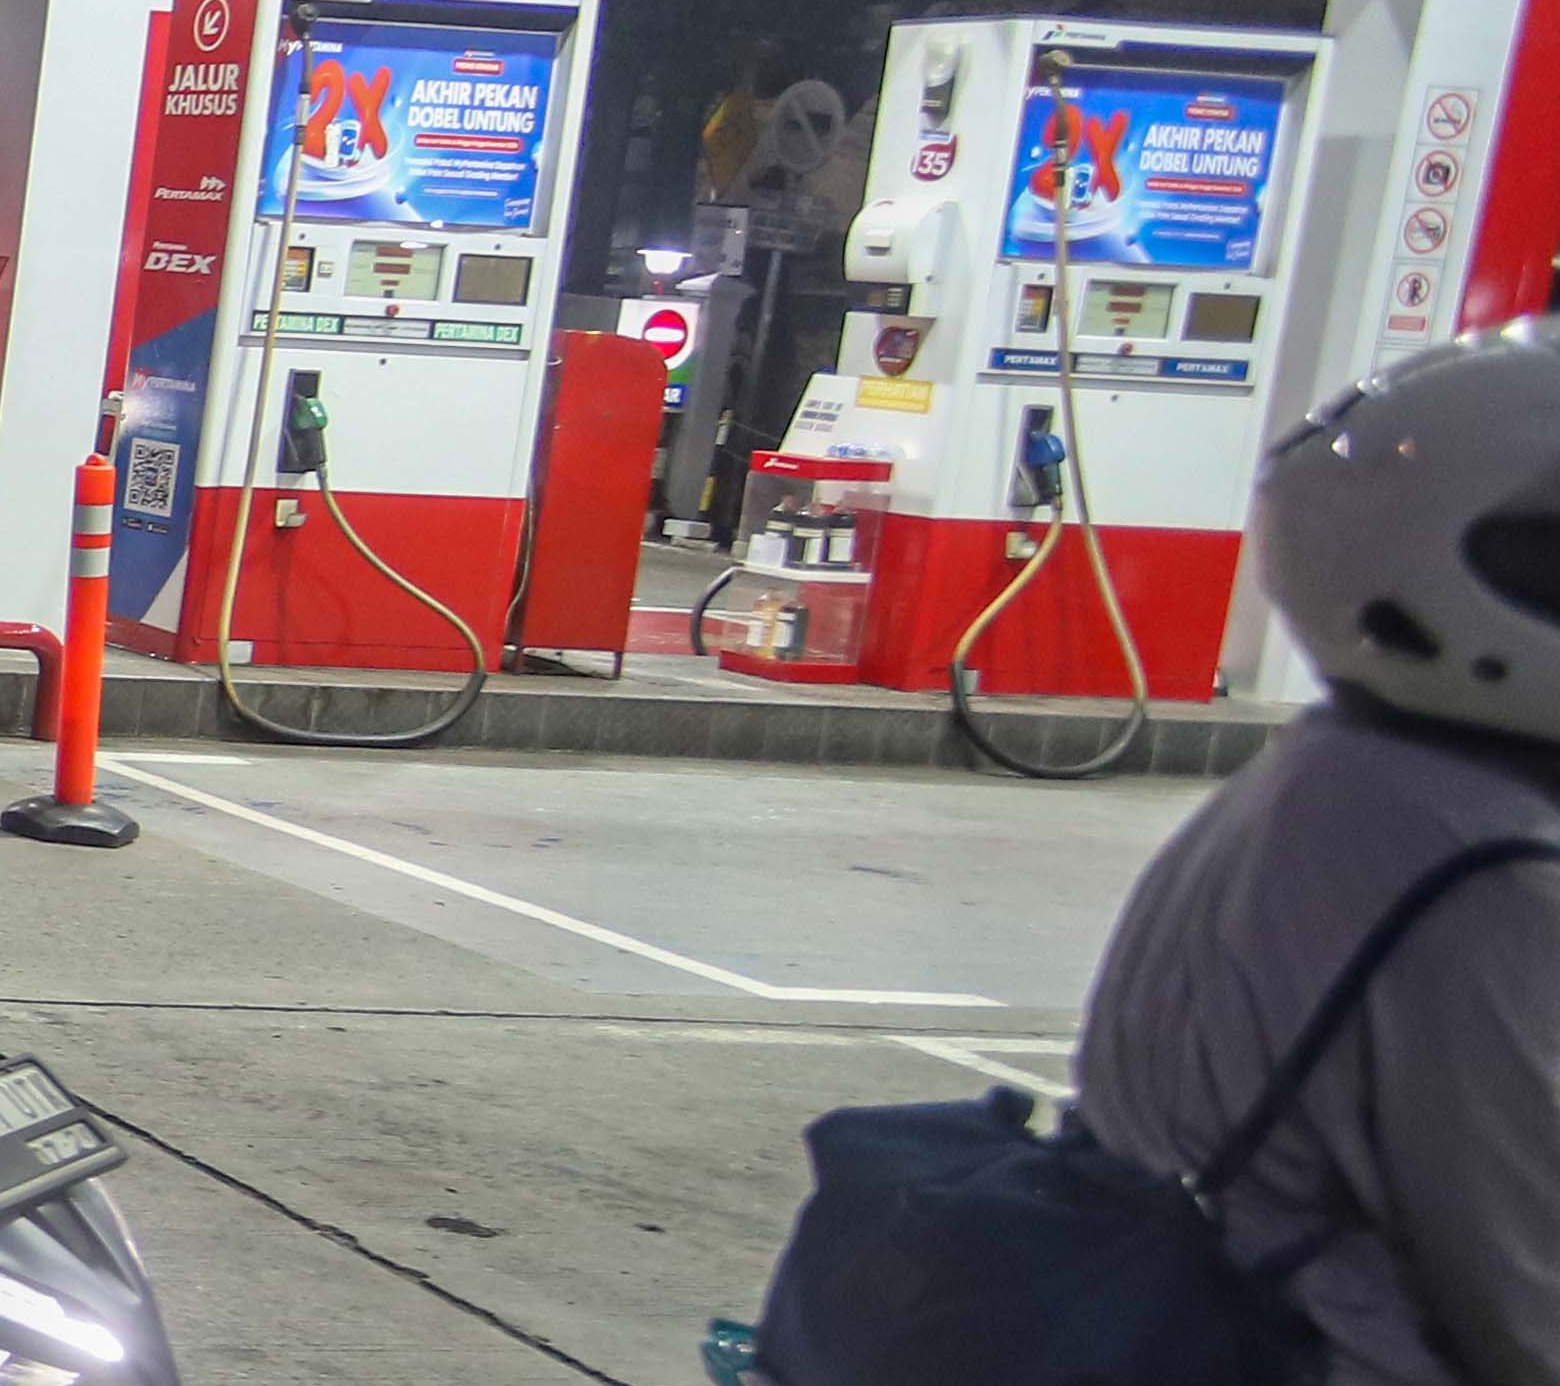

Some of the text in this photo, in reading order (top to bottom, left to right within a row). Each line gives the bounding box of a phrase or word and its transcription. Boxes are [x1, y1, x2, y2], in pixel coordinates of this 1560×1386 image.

[168, 63, 240, 92] JALUR
[164, 93, 237, 116] KHUSUS
[410, 79, 539, 109] AKHIR PEKAN
[407, 106, 536, 133] DOBEL UNTUNG
[1143, 125, 1264, 154] AKHIR PEKAN
[1139, 151, 1260, 177] DOBEL UNTUNG
[154, 187, 224, 201] PERTAMAX
[143, 252, 217, 274] DEX
[253, 314, 314, 332] PETAMINA
[317, 318, 339, 333] DEX
[434, 324, 494, 342] PERTAMINA
[497, 327, 518, 342] DEX
[1003, 354, 1057, 366] PERTAMAX
[1175, 362, 1229, 374] PERTAMAX
